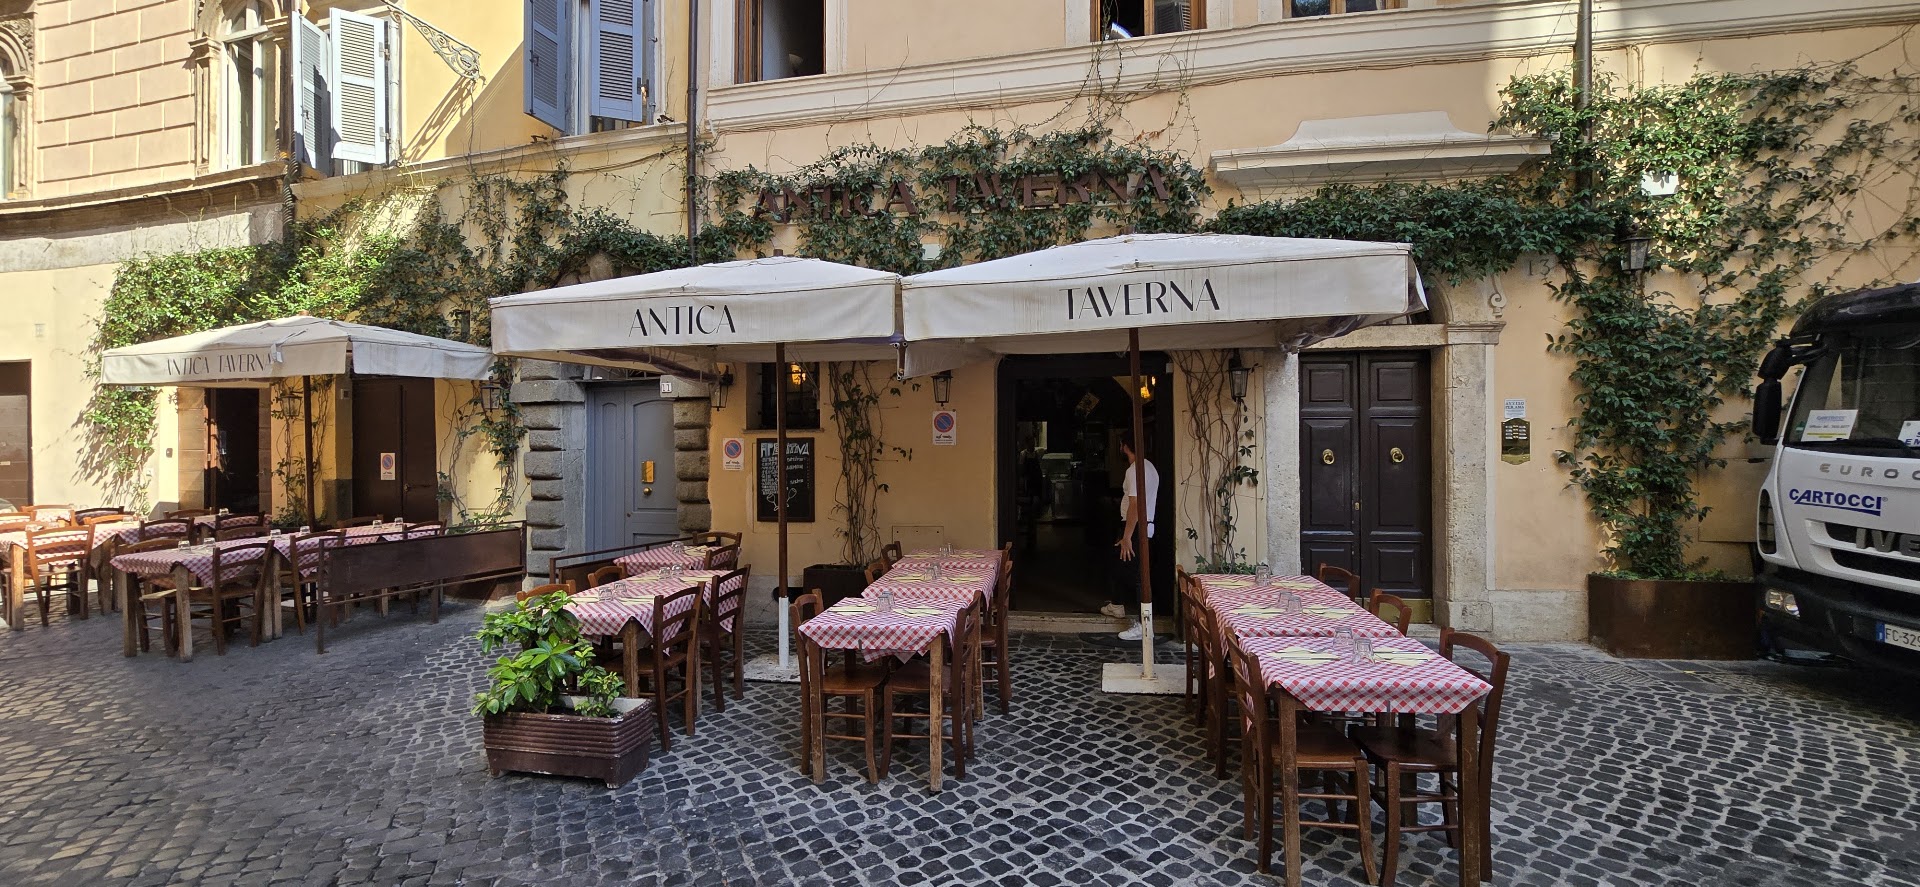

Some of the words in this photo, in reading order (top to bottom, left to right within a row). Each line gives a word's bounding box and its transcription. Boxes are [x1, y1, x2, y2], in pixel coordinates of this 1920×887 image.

[1528, 258, 1551, 276] 13
[1059, 278, 1220, 320] TAVERNA
[629, 304, 736, 338] ANTICA
[165, 356, 210, 376] ANTICA
[1789, 489, 1881, 510] CARTOCCI
